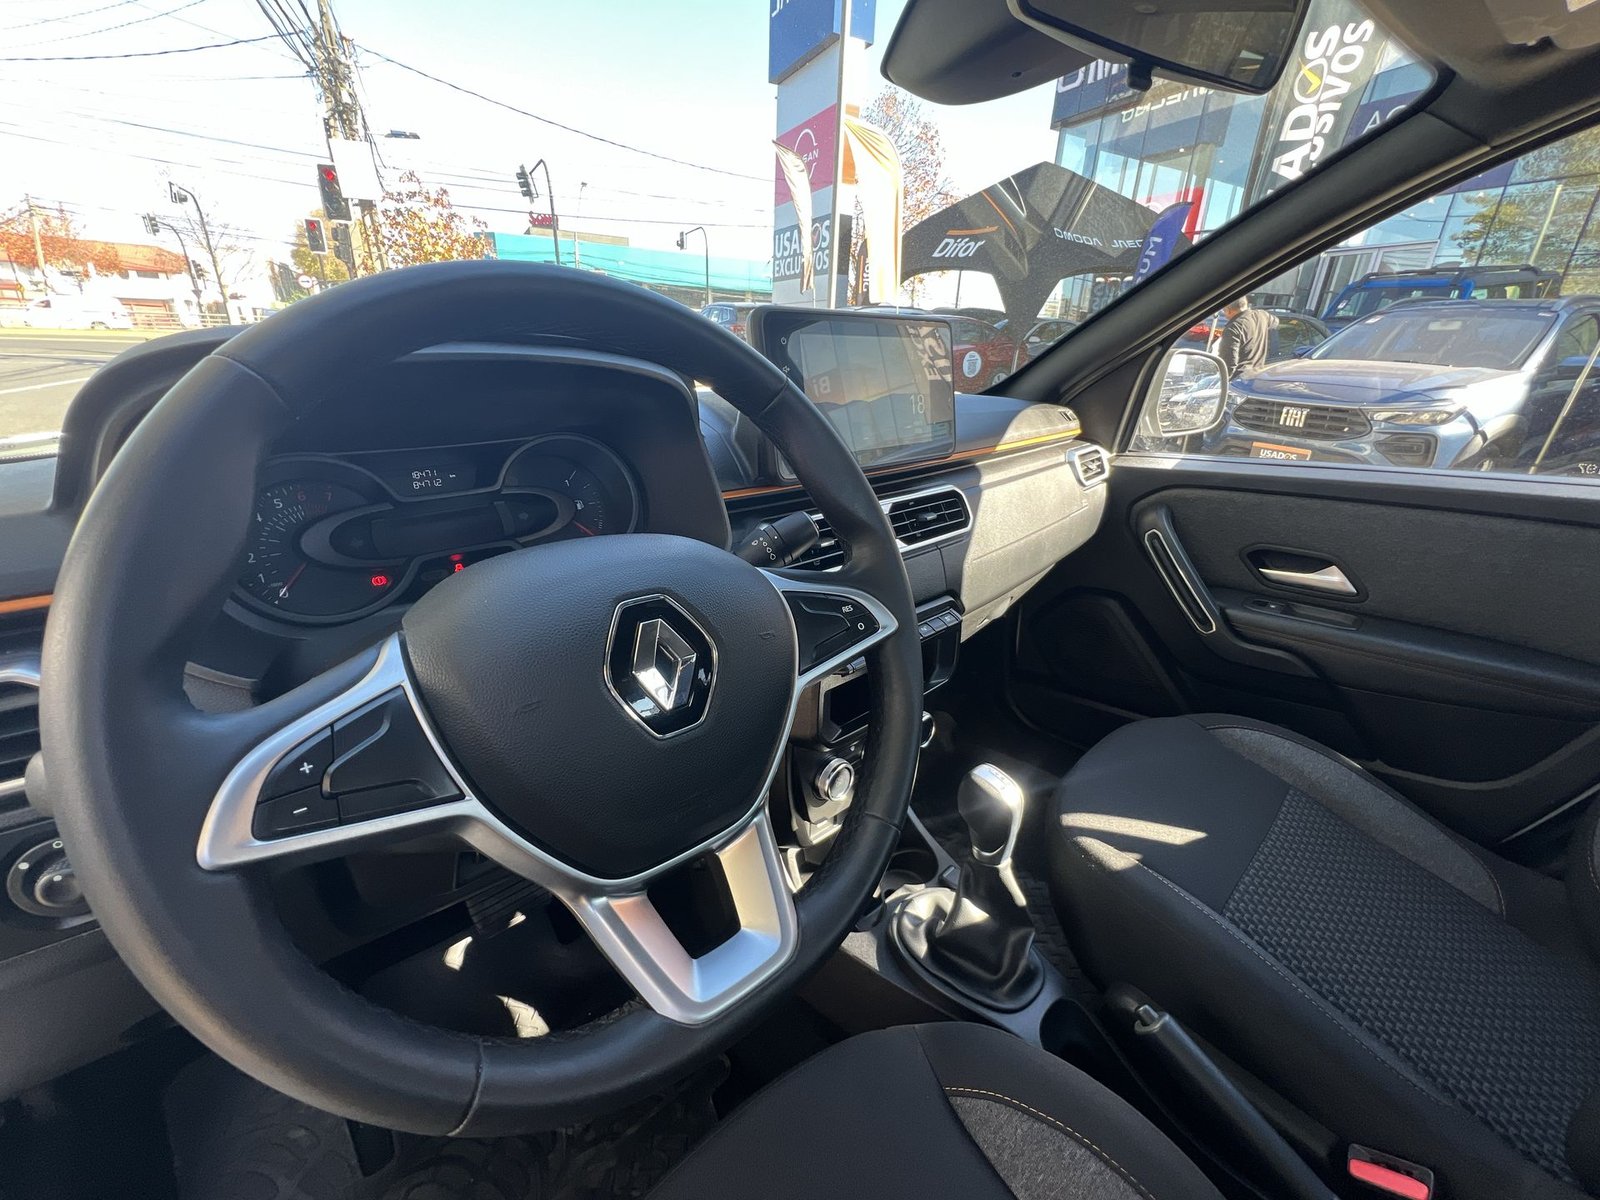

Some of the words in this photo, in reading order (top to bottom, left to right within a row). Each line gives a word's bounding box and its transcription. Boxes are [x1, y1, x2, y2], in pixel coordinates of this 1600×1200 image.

[1271, 24, 1341, 181] ADOS
[775, 220, 830, 258] USAOS
[932, 238, 986, 257] Difor
[1111, 239, 1144, 249] JAEC
[774, 250, 829, 277] EXCLUOS
[1280, 406, 1310, 428] FIAT
[1260, 448, 1298, 460] USADOS
[273, 498, 283, 508] 5
[248, 553, 256, 563] 2
